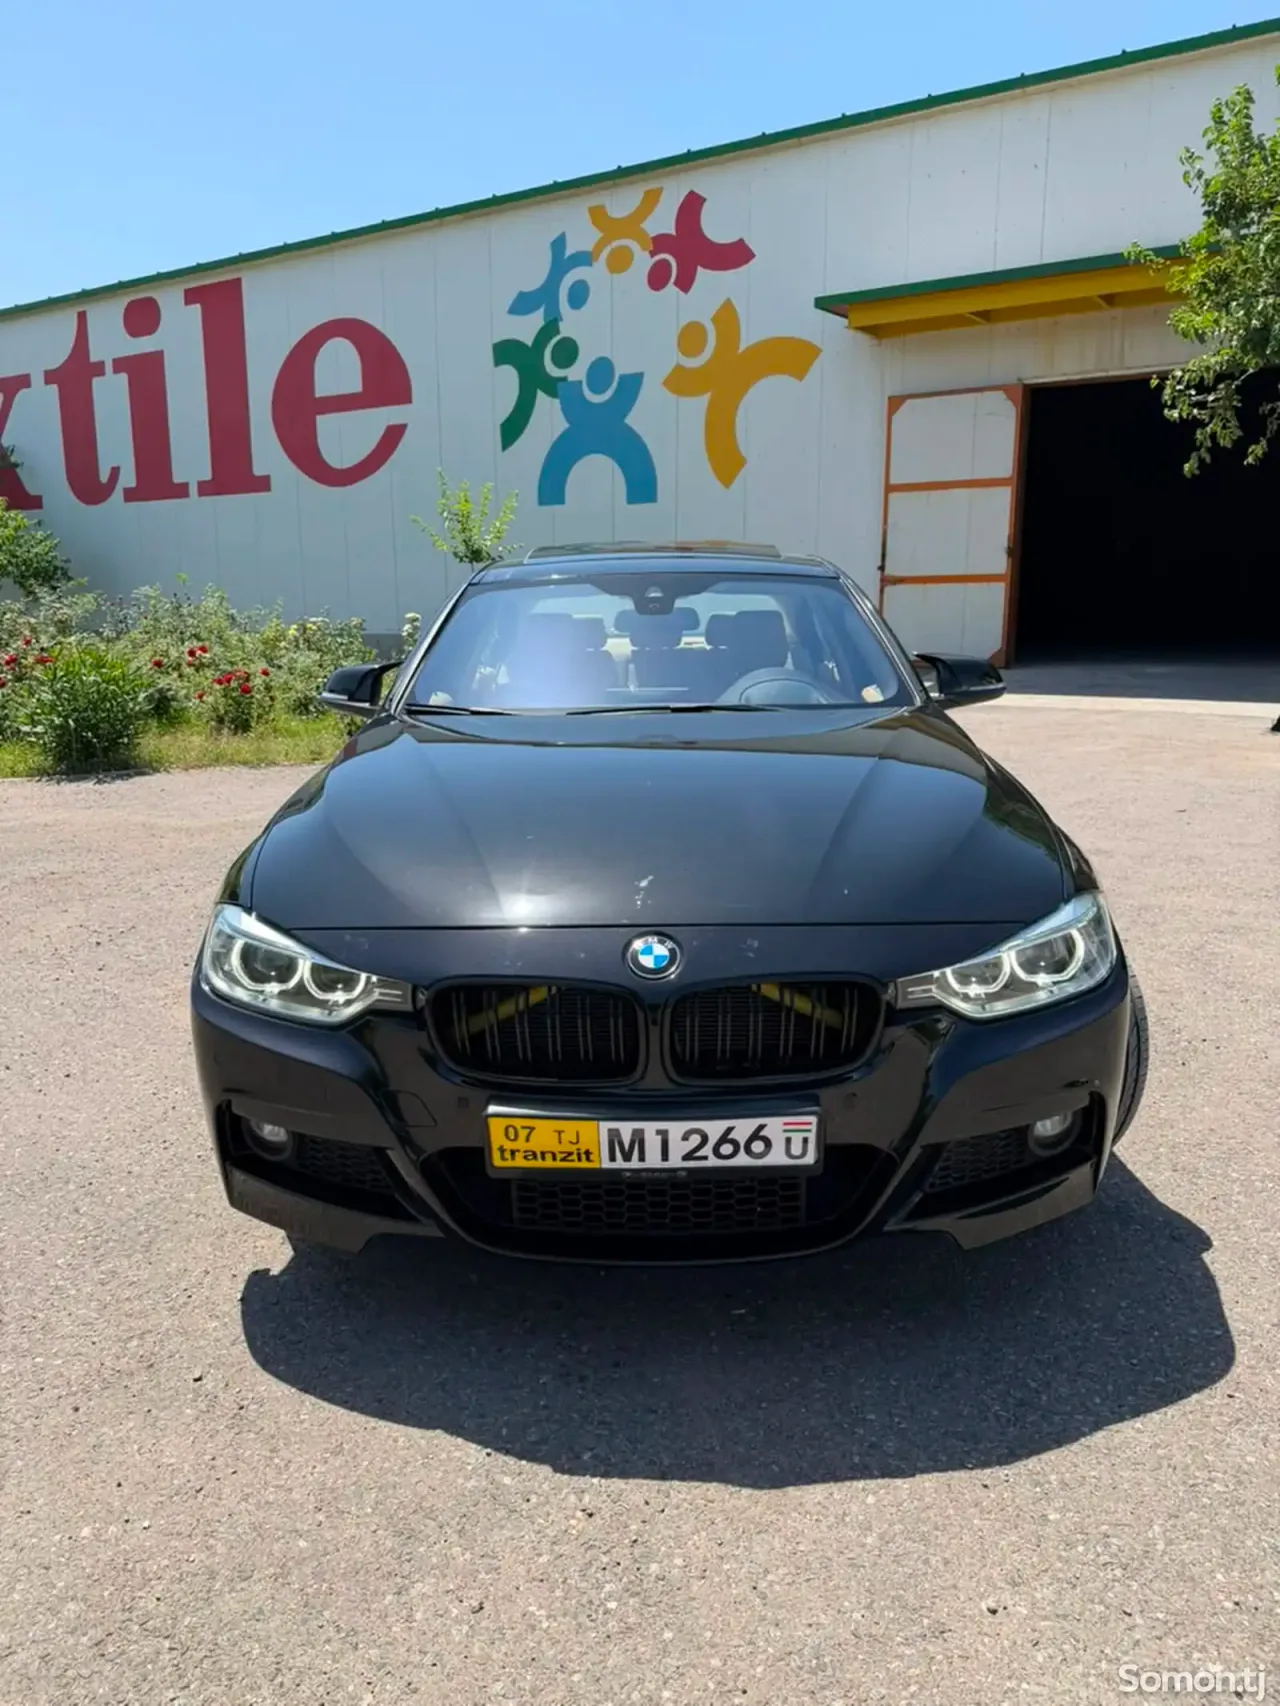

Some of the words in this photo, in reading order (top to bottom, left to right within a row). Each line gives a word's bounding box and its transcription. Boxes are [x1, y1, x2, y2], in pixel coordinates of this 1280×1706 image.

[504, 1124, 536, 1143] 07
[553, 1130, 580, 1145] TJ
[606, 1123, 773, 1163] M1266
[497, 1145, 595, 1163] tranzit
[784, 1136, 809, 1160] U
